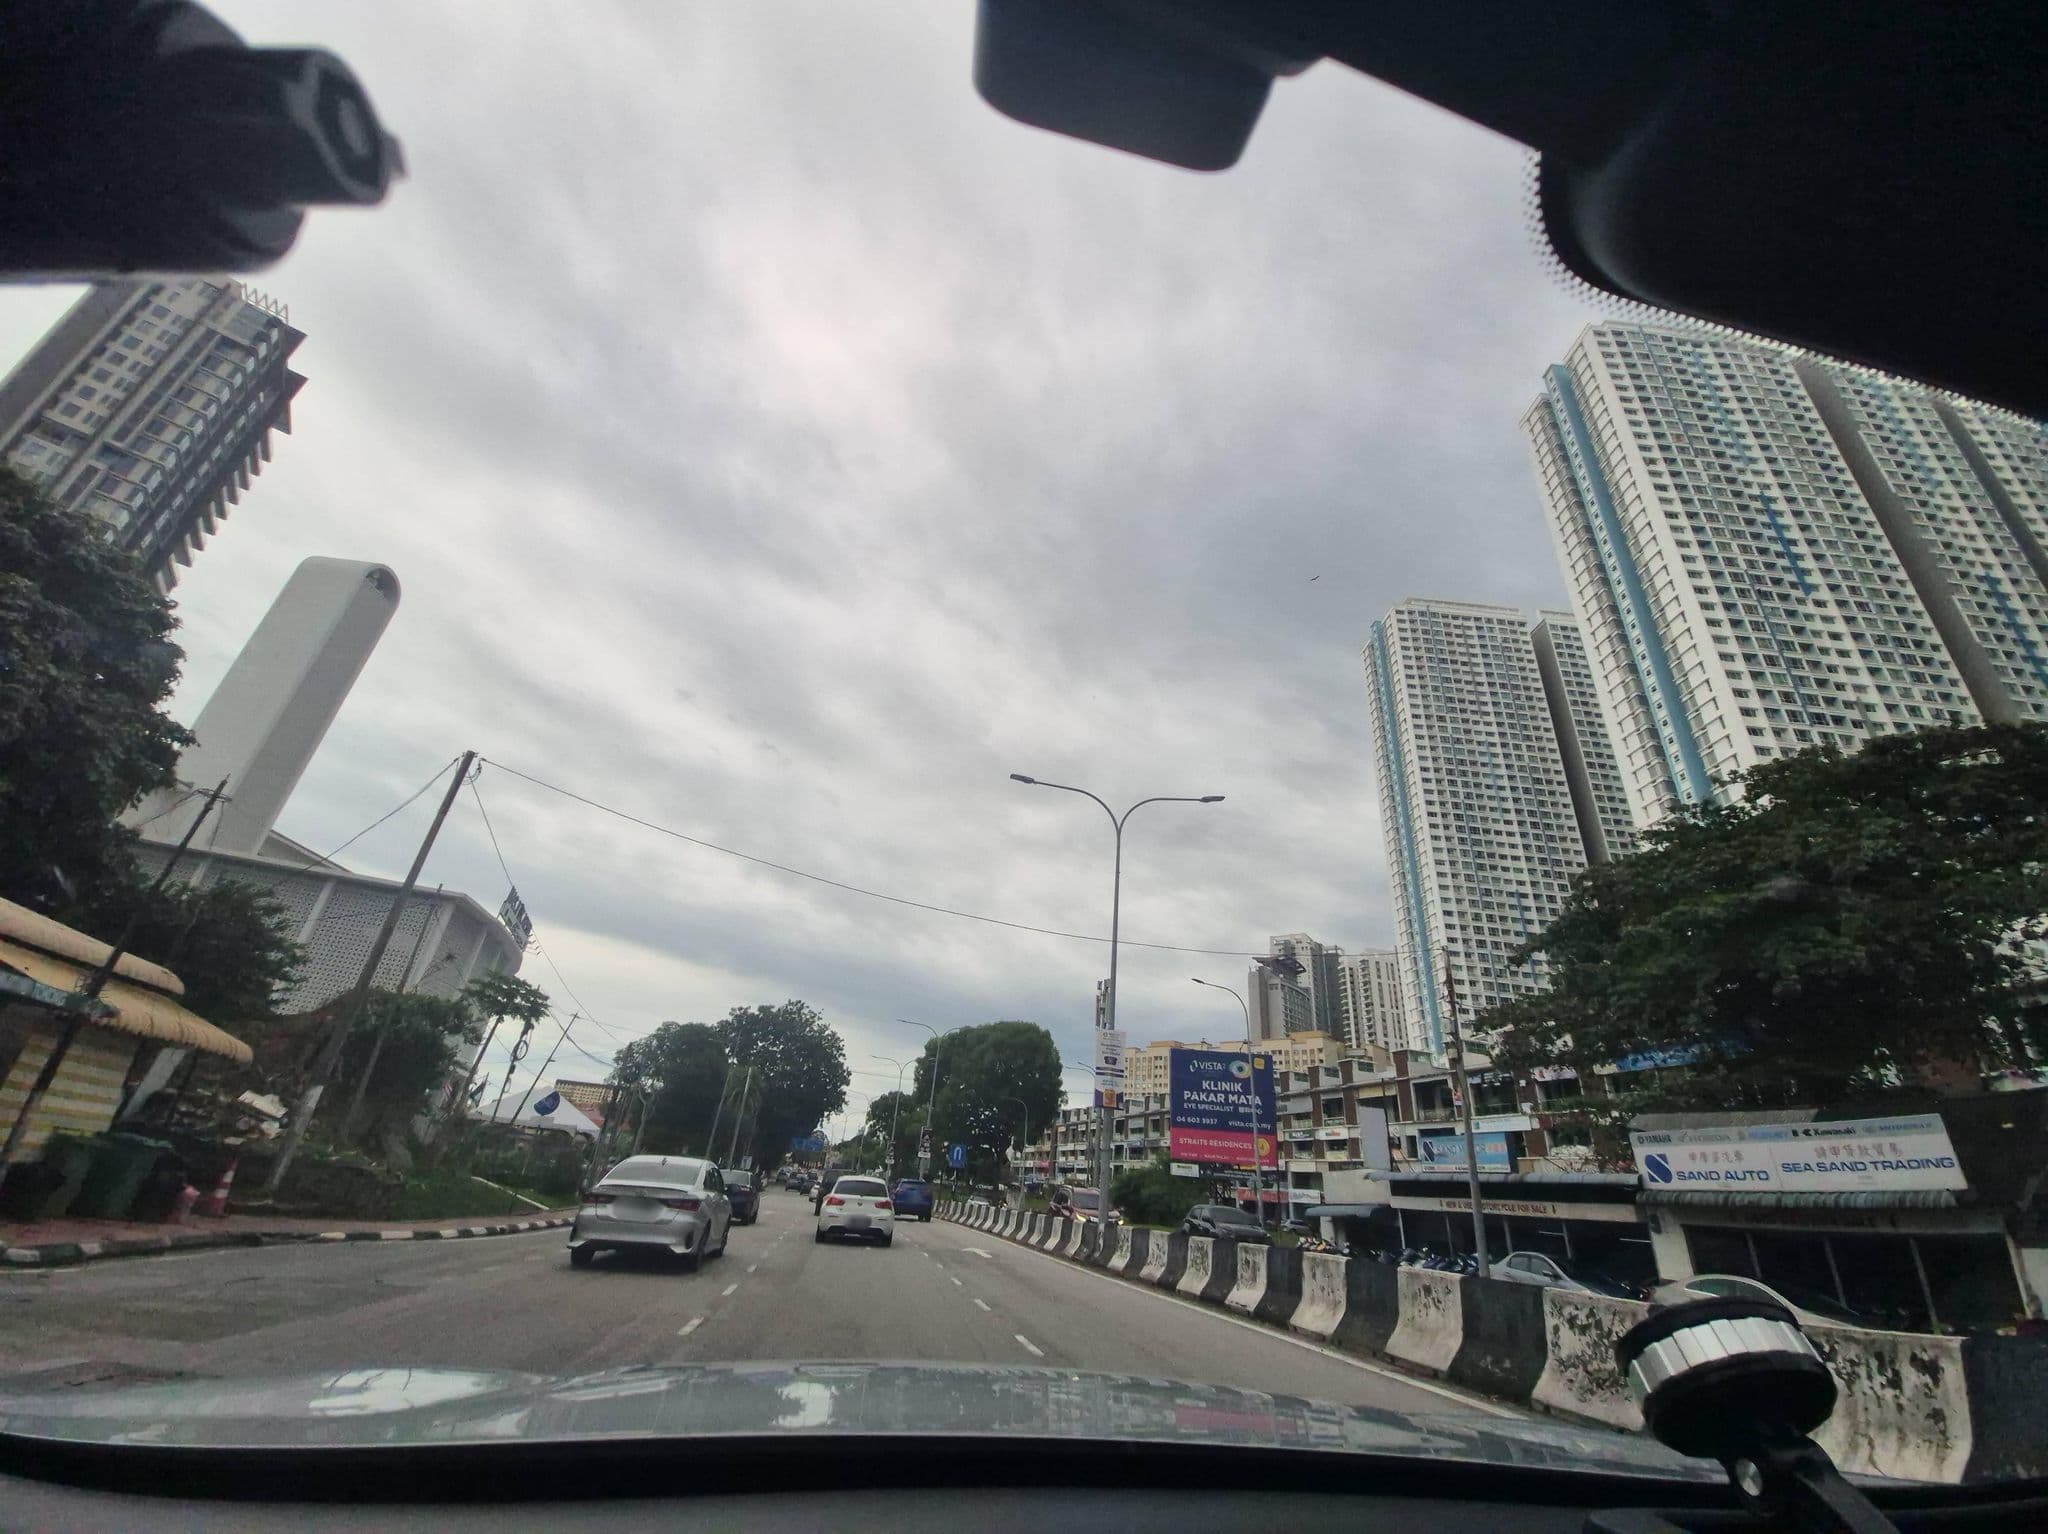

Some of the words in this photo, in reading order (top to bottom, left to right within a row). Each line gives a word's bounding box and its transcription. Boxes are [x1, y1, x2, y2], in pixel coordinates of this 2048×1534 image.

[1199, 1062, 1223, 1071] VISTA
[1202, 1080, 1243, 1092] KLINIK
[1183, 1090, 1225, 1103] PAKAR
[1228, 1094, 1262, 1105] MATA
[1197, 1103, 1234, 1112] SPECIALIST
[1179, 1137, 1208, 1146] STRAITS
[1209, 1140, 1252, 1150] RESIDENCES
[1781, 1162, 1815, 1173] SEA
[1816, 1160, 1868, 1172] SAND
[1869, 1157, 1956, 1171] TRADING
[1676, 1170, 1720, 1181] SAND
[1724, 1170, 1769, 1181] AUTO
